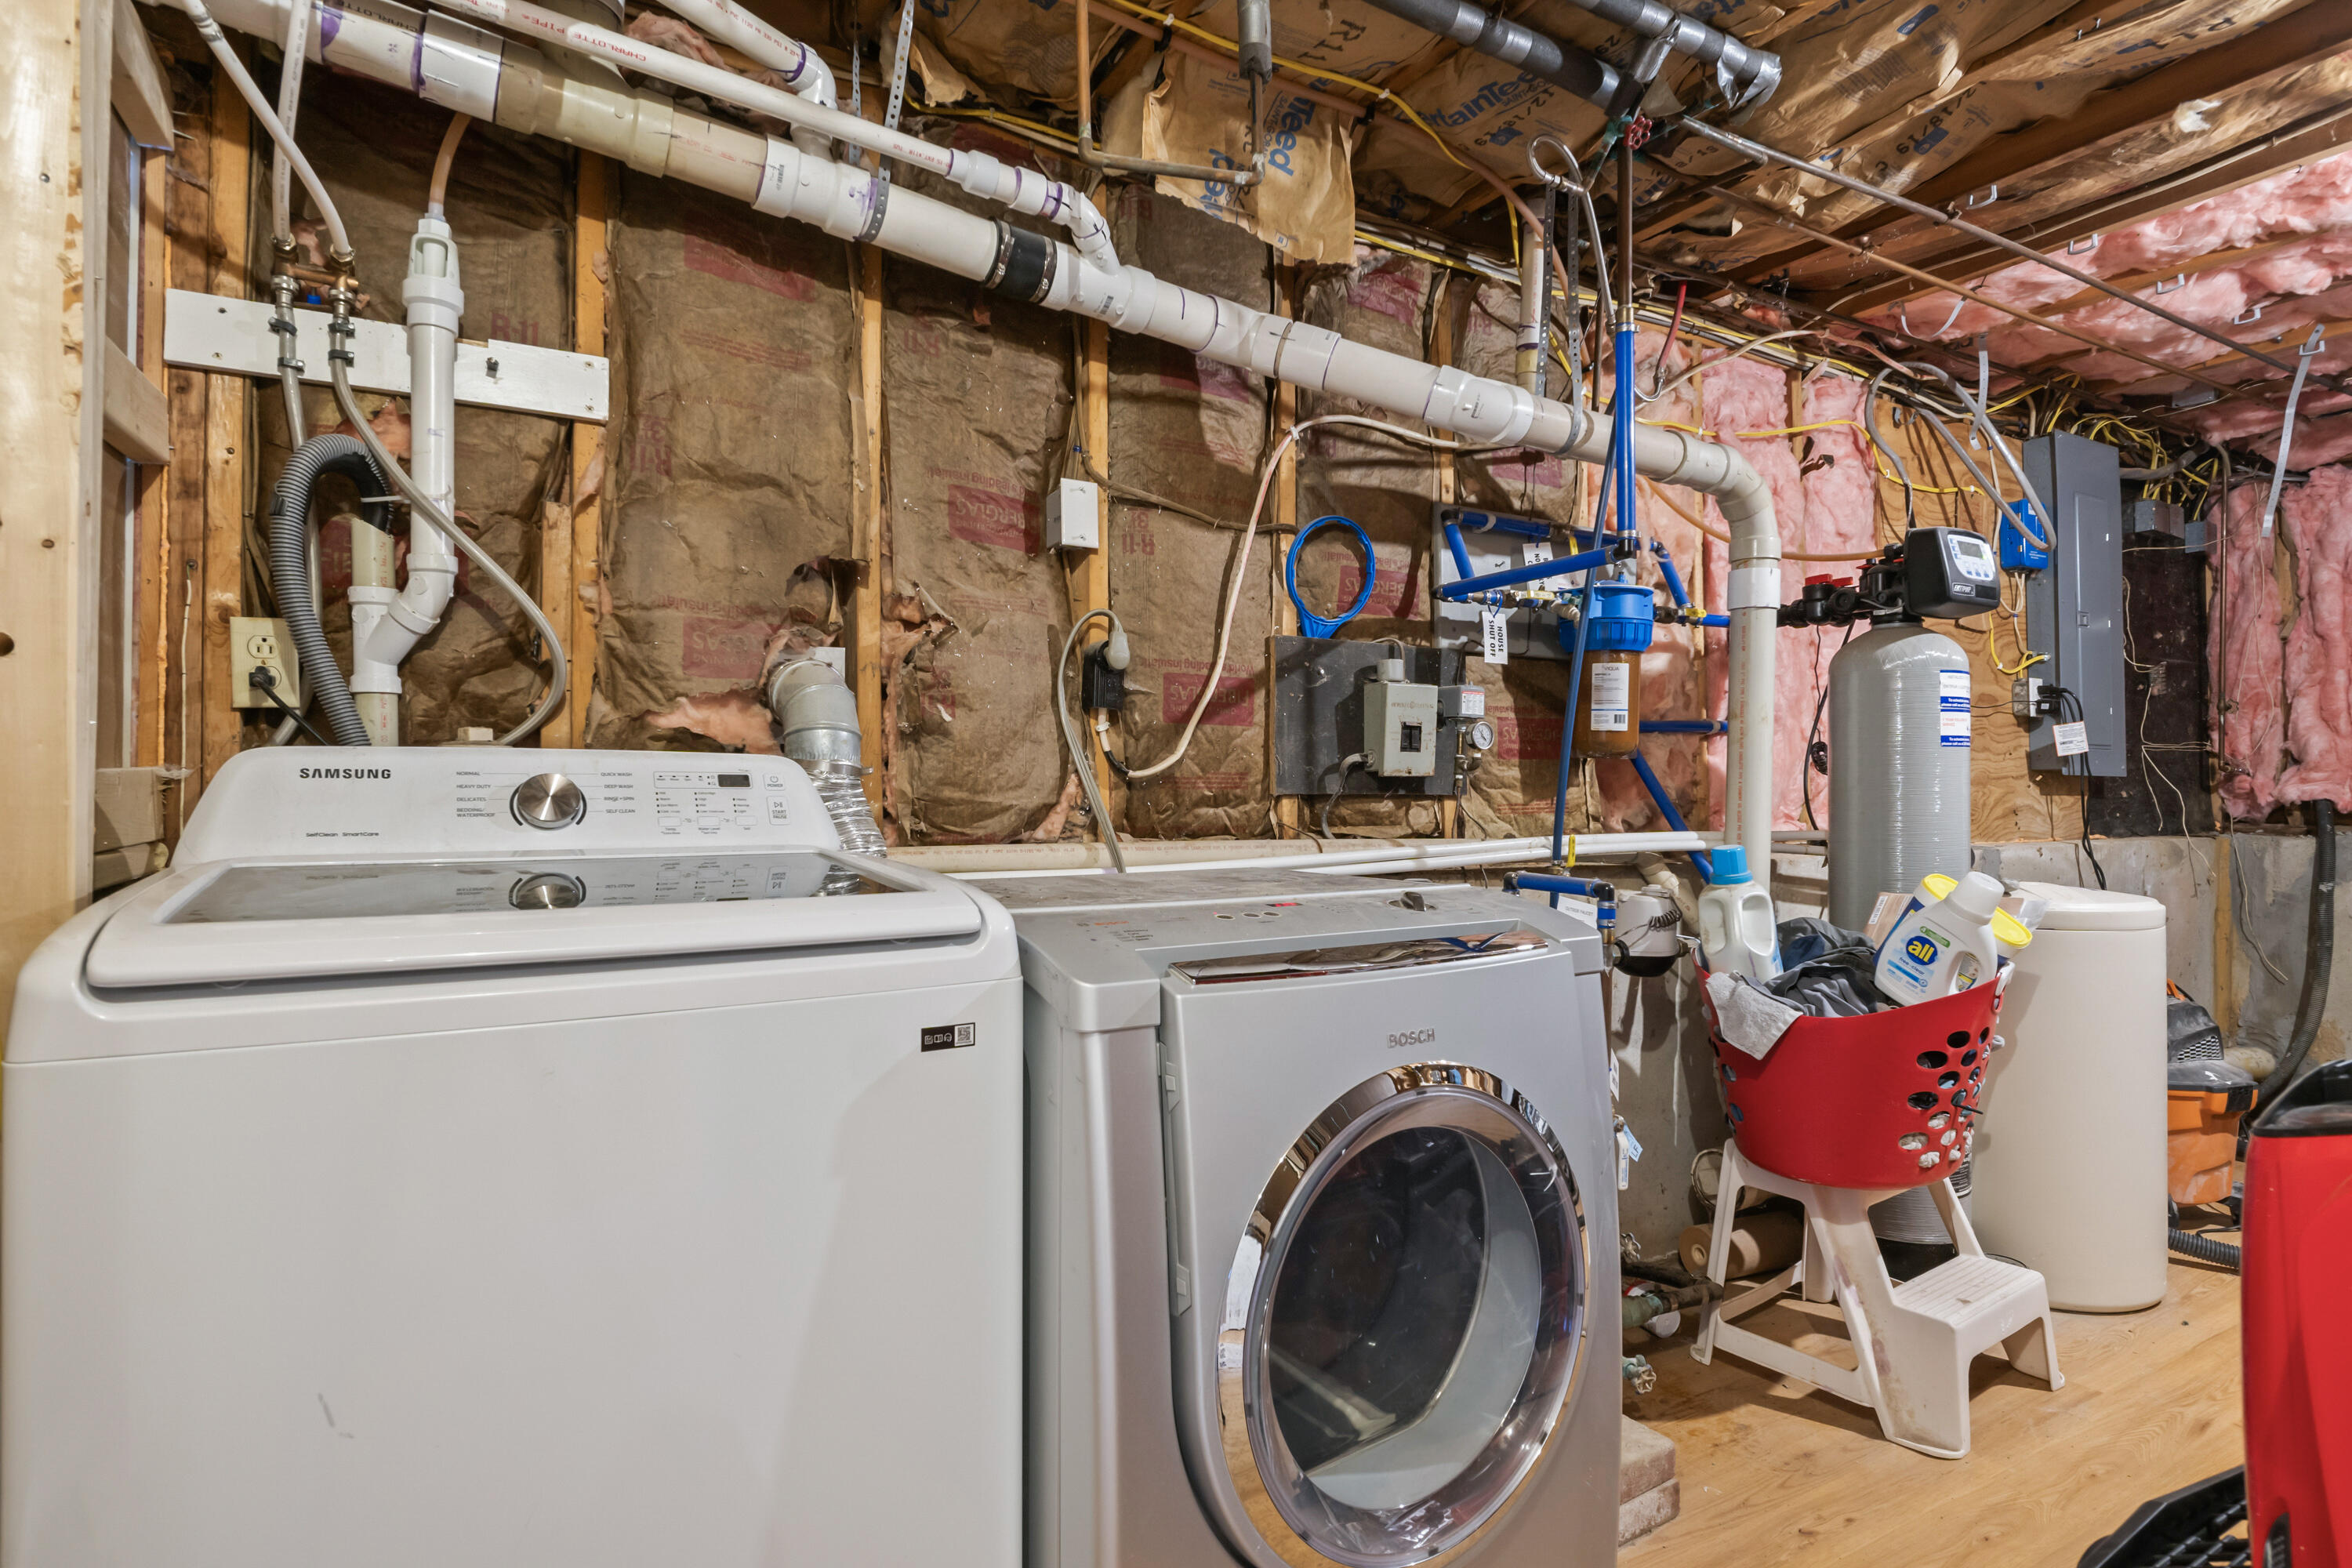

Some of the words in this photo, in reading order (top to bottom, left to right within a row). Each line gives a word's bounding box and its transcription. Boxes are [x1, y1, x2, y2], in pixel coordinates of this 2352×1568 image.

[572, 32, 646, 61] CHARLOTTE
[490, 313, 539, 346] R-11
[1123, 533, 1155, 556] R-11
[299, 768, 392, 779] SAMSUNG
[1907, 940, 1935, 963] all
[1386, 1028, 1436, 1049] BOSCH
